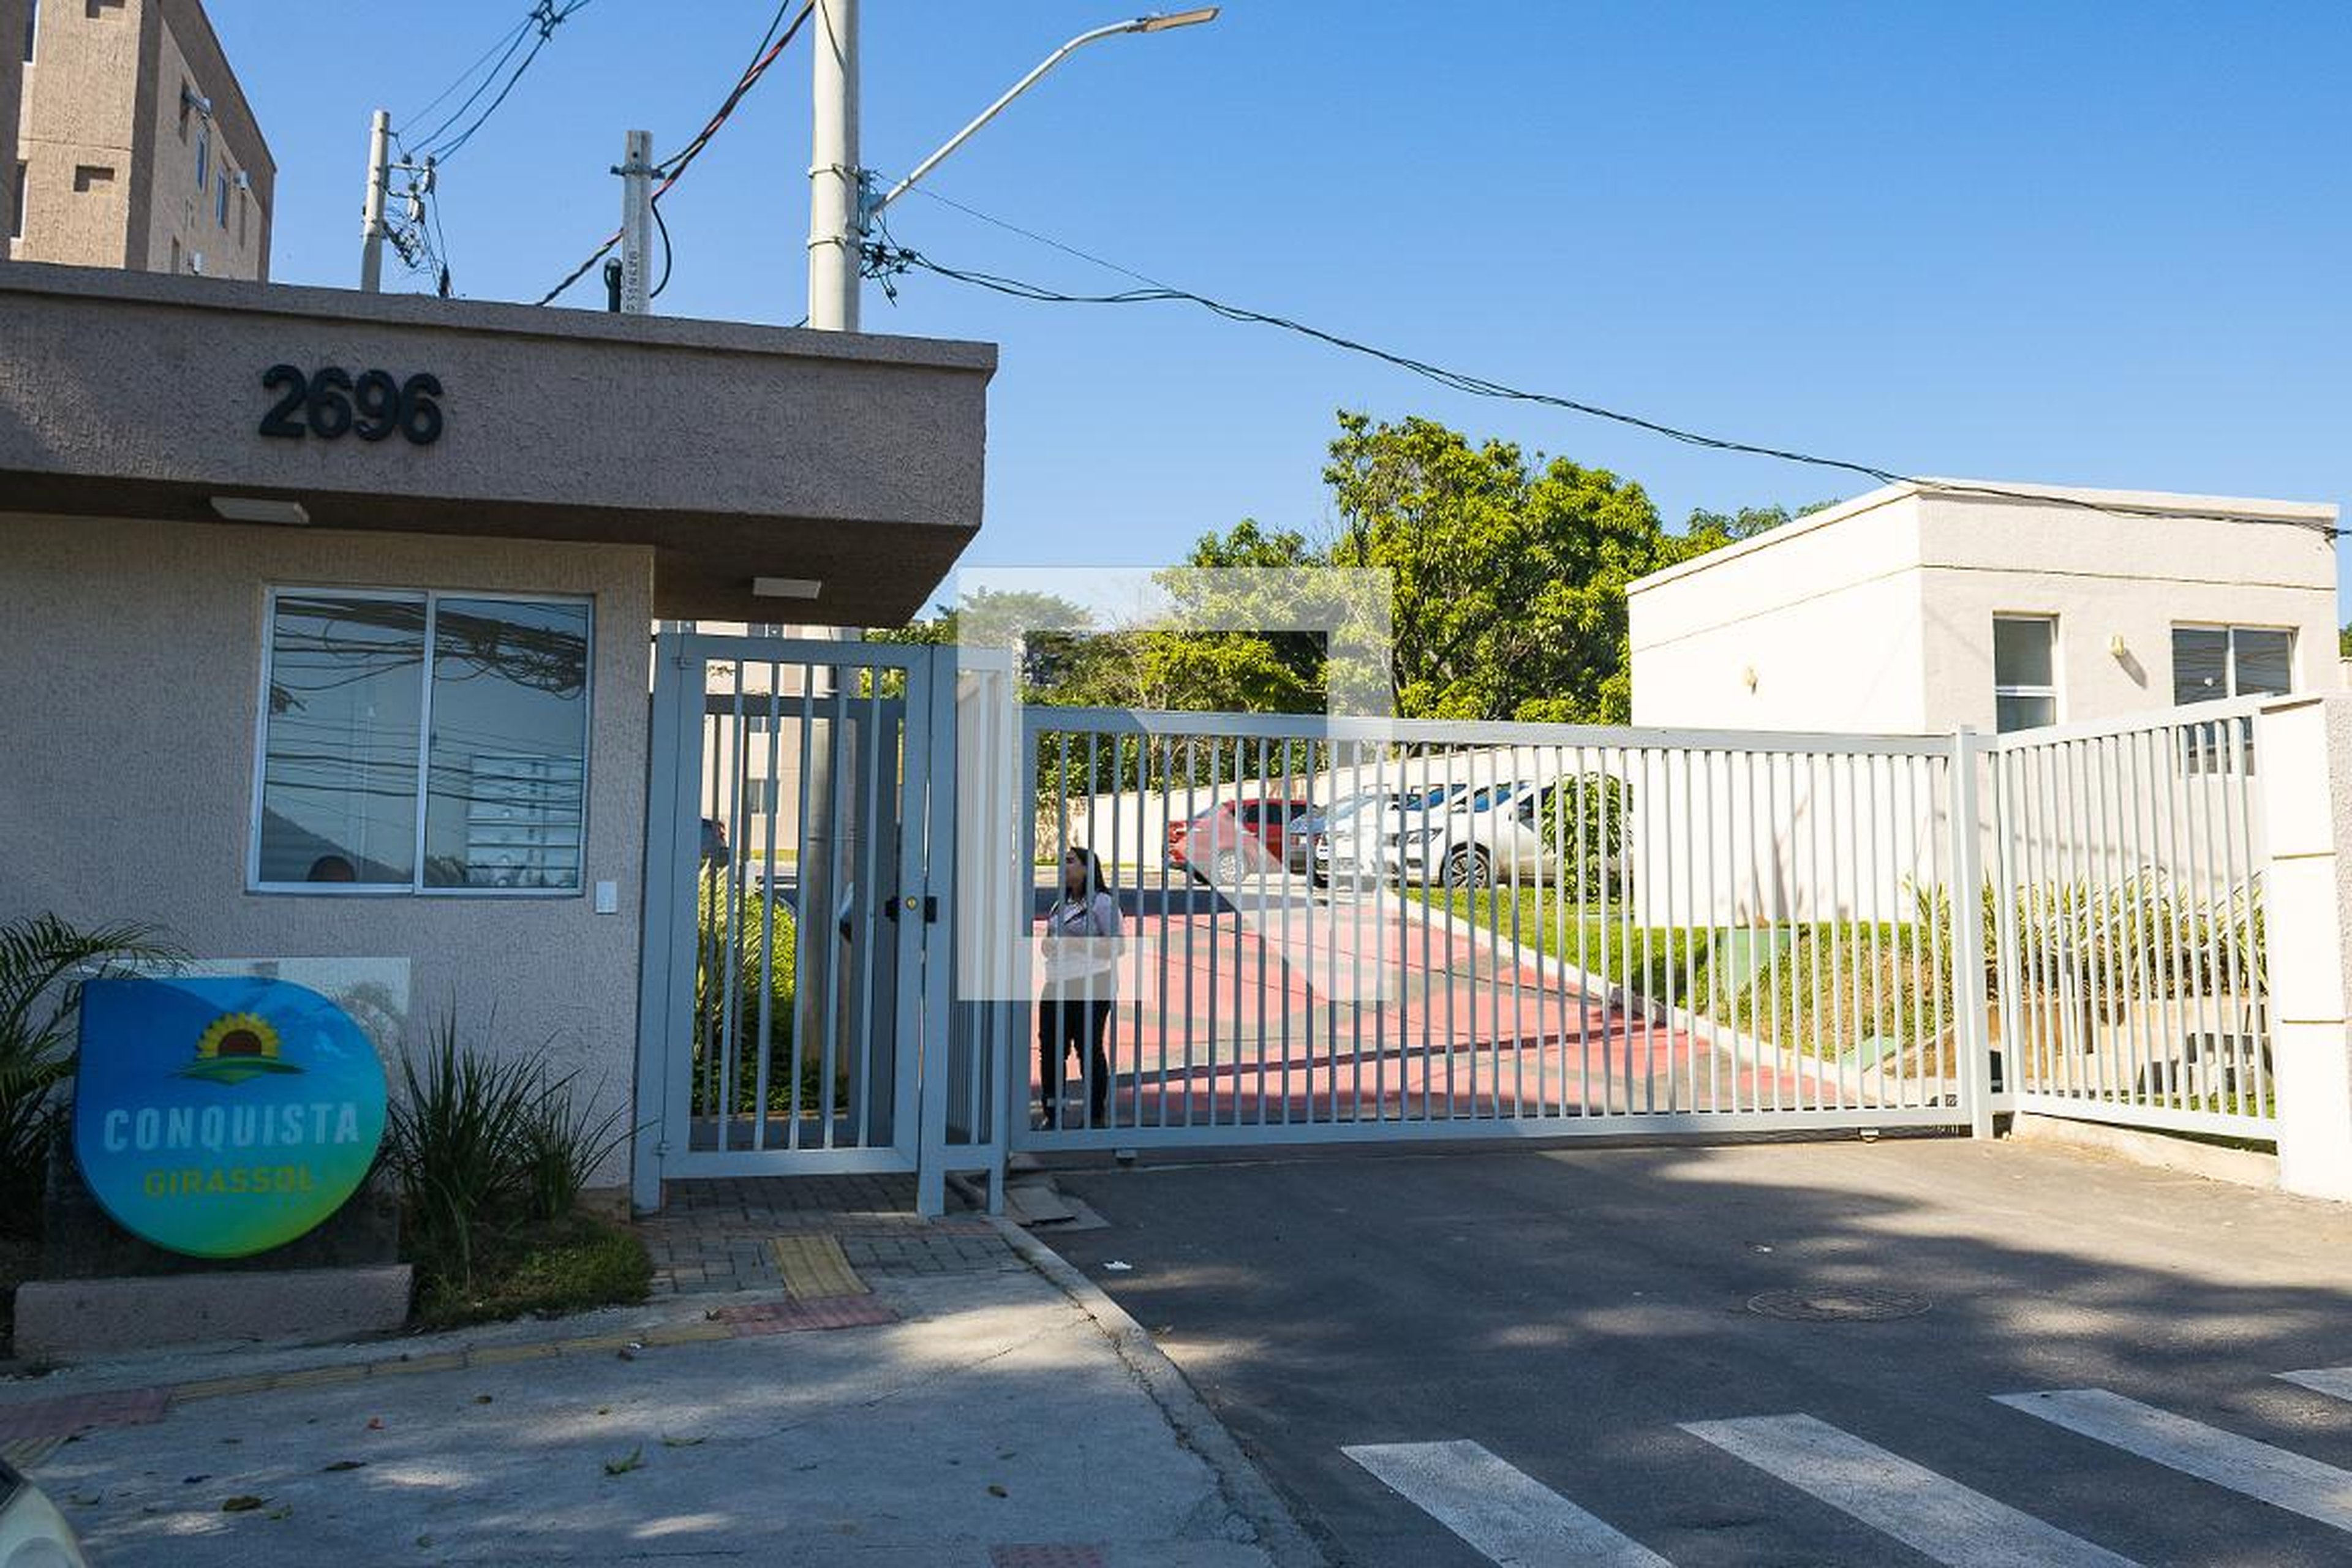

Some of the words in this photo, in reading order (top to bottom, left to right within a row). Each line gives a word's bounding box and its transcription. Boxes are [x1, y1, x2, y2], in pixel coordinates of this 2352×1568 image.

[258, 363, 443, 445] 2696
[104, 1102, 360, 1152] CONQUISTA
[145, 1163, 314, 1199] GIRASSOL
